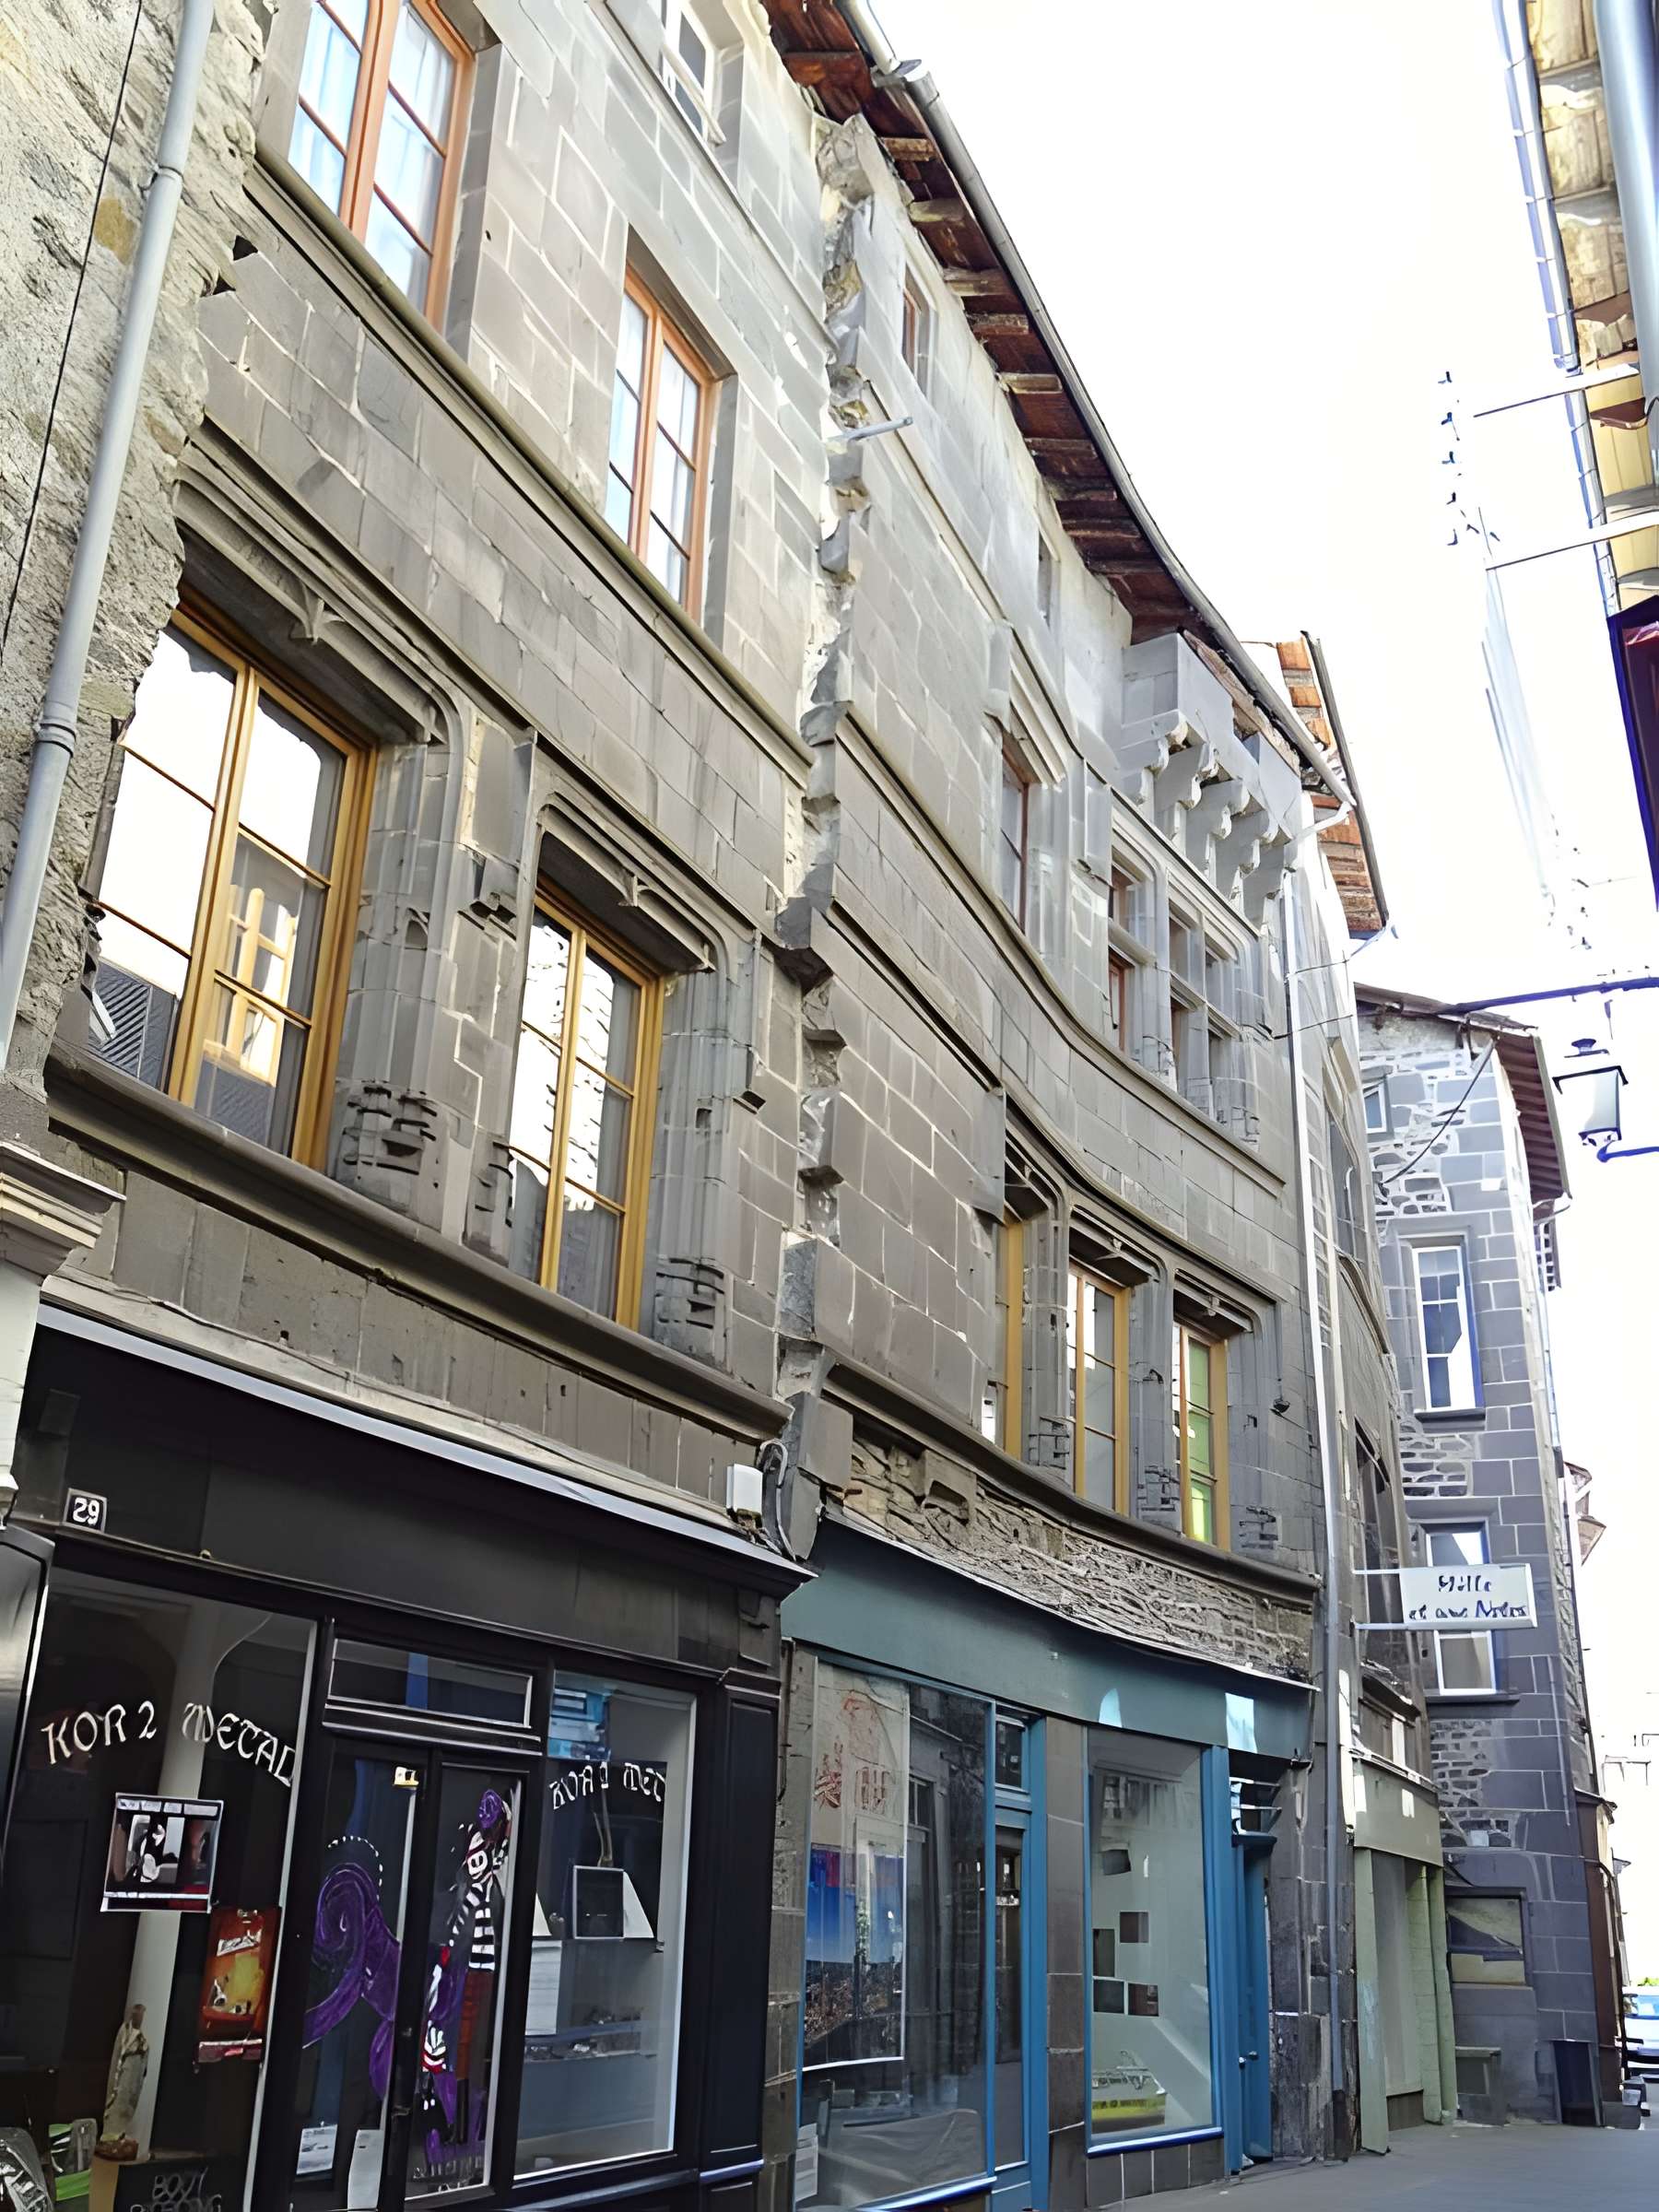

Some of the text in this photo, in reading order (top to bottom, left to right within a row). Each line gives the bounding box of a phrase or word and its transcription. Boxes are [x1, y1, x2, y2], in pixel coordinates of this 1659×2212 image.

[72, 1497, 100, 1525] 29
[41, 1703, 126, 1765] KOR
[138, 1700, 157, 1739] 2
